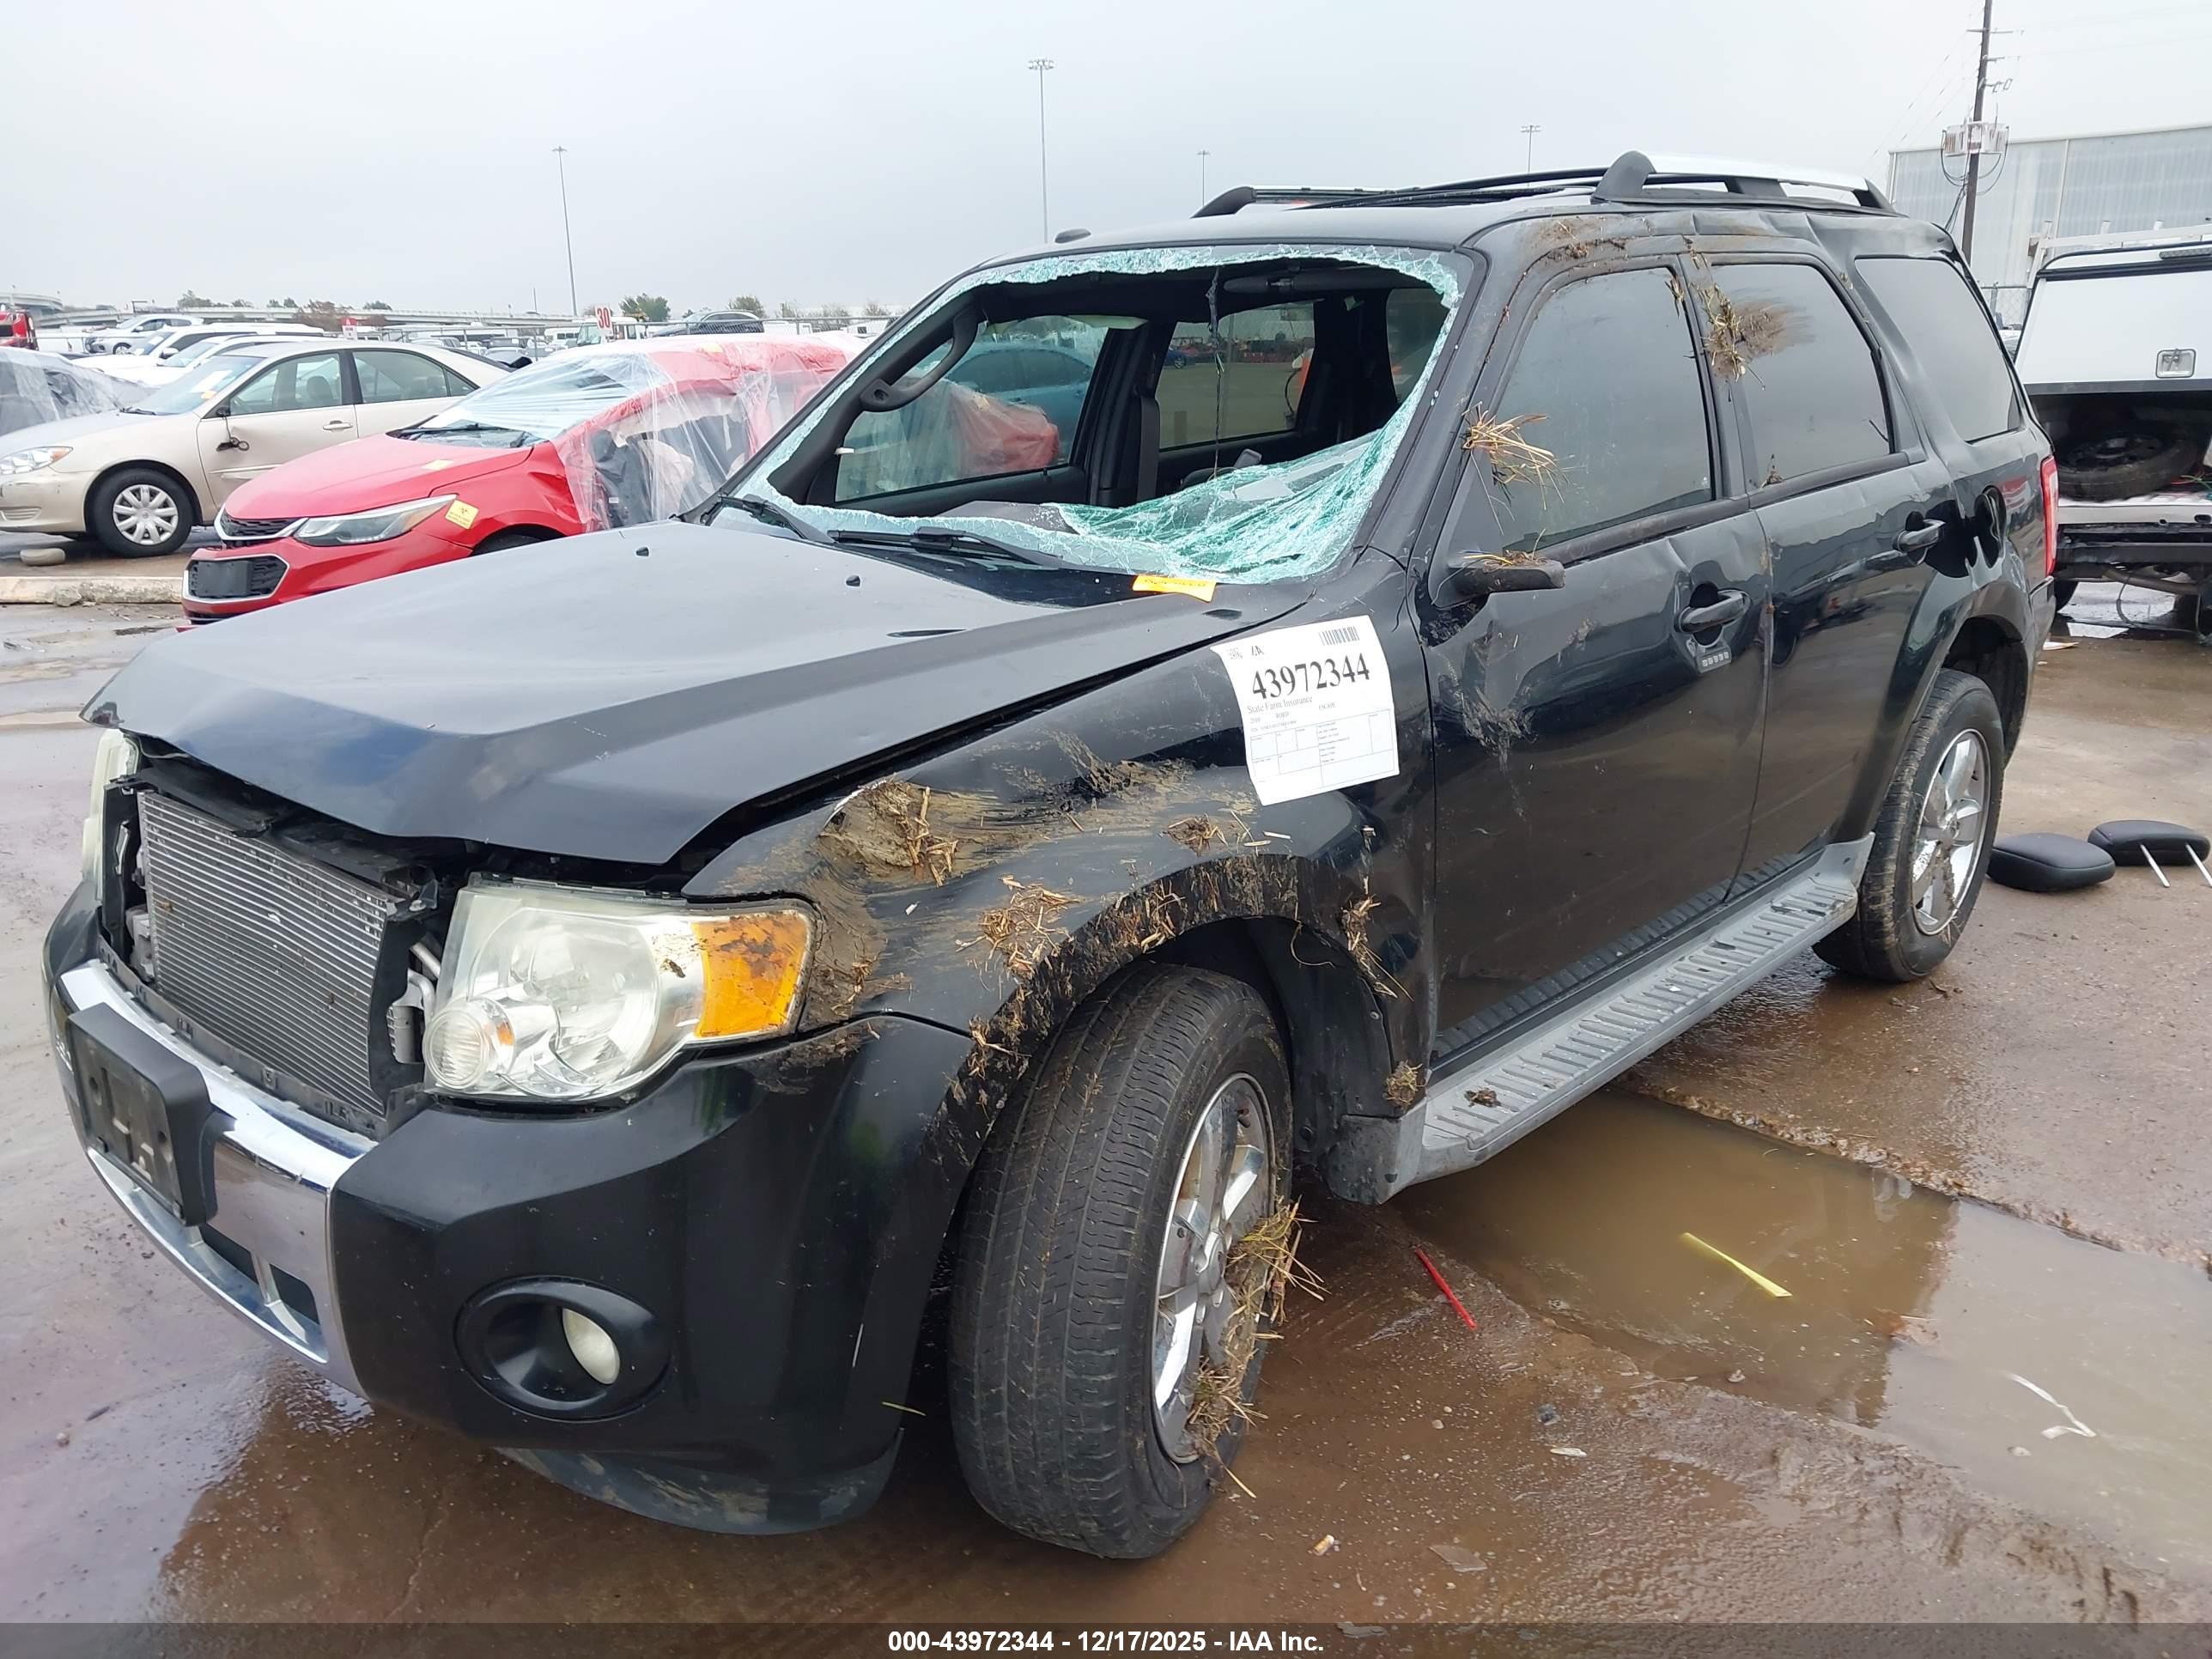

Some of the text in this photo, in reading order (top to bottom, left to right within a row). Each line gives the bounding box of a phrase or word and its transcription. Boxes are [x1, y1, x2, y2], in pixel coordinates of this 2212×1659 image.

[597, 307, 610, 328] 30
[1252, 653, 1370, 699] 43972344
[1247, 696, 1313, 714] State Farm Insurance
